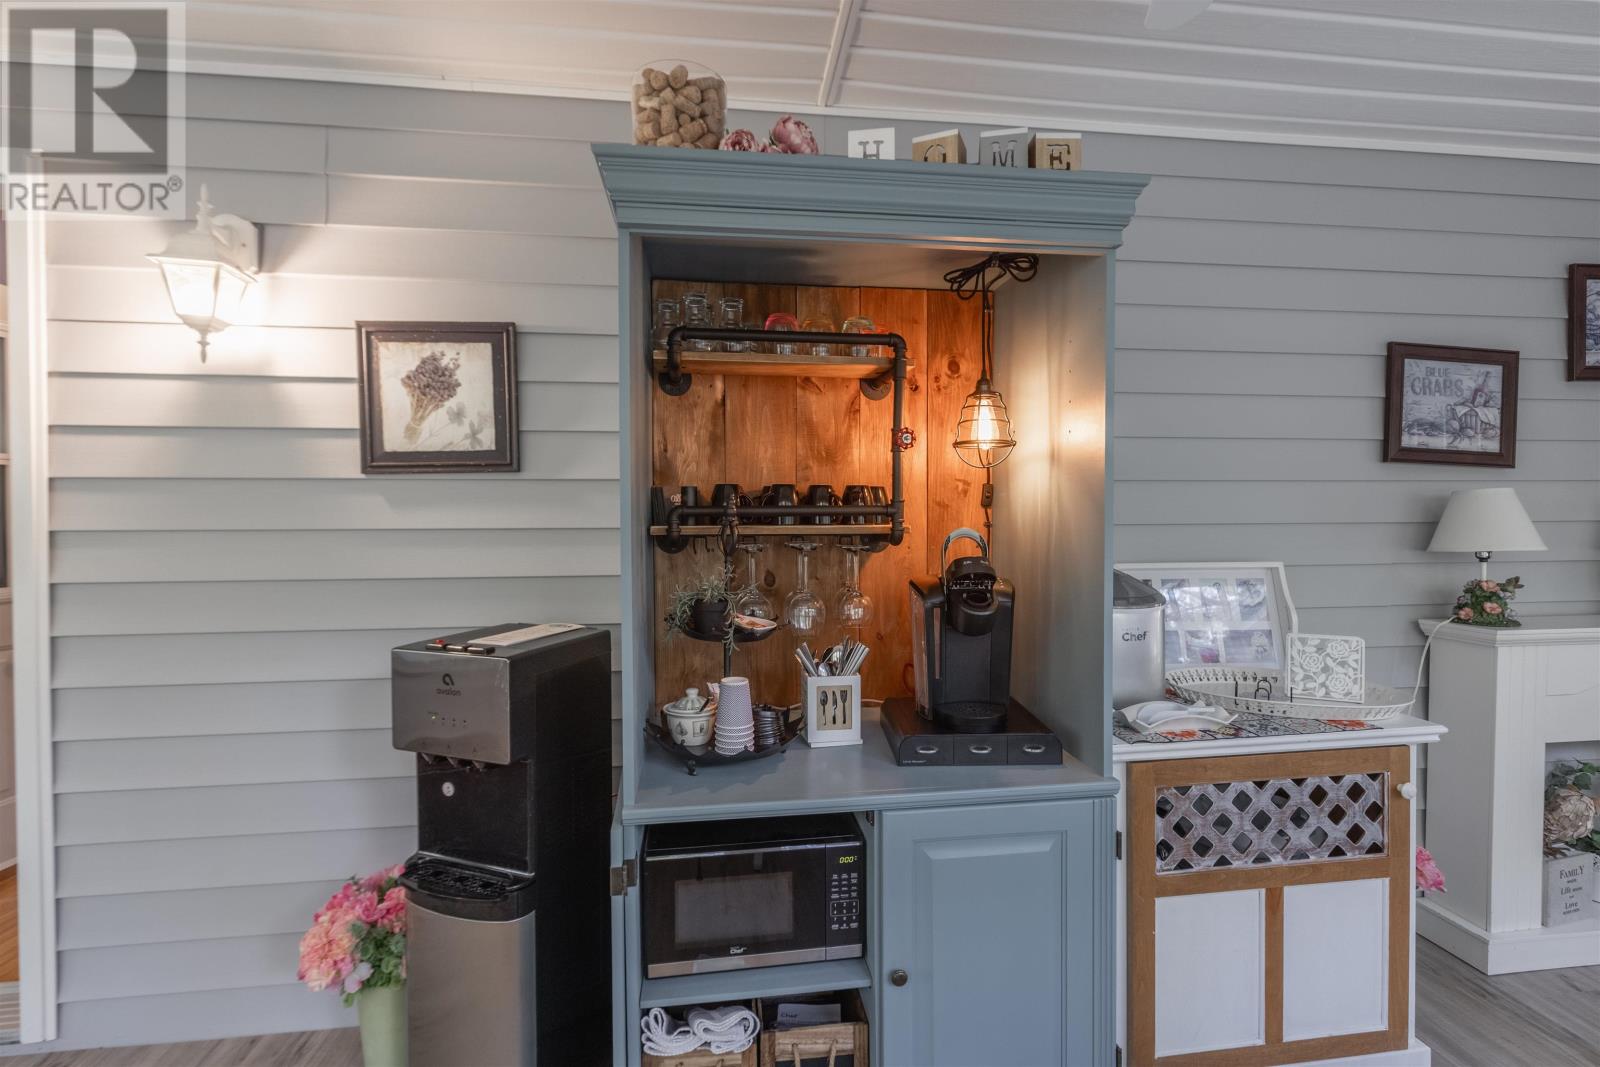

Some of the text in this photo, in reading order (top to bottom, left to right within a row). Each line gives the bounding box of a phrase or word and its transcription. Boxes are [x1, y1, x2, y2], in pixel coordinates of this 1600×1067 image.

[1425, 366, 1451, 378] BLUE
[1411, 377, 1465, 397] CRABS
[1122, 631, 1148, 642] Chef
[435, 688, 462, 697] avalon
[1560, 865, 1585, 879] FAMILY
